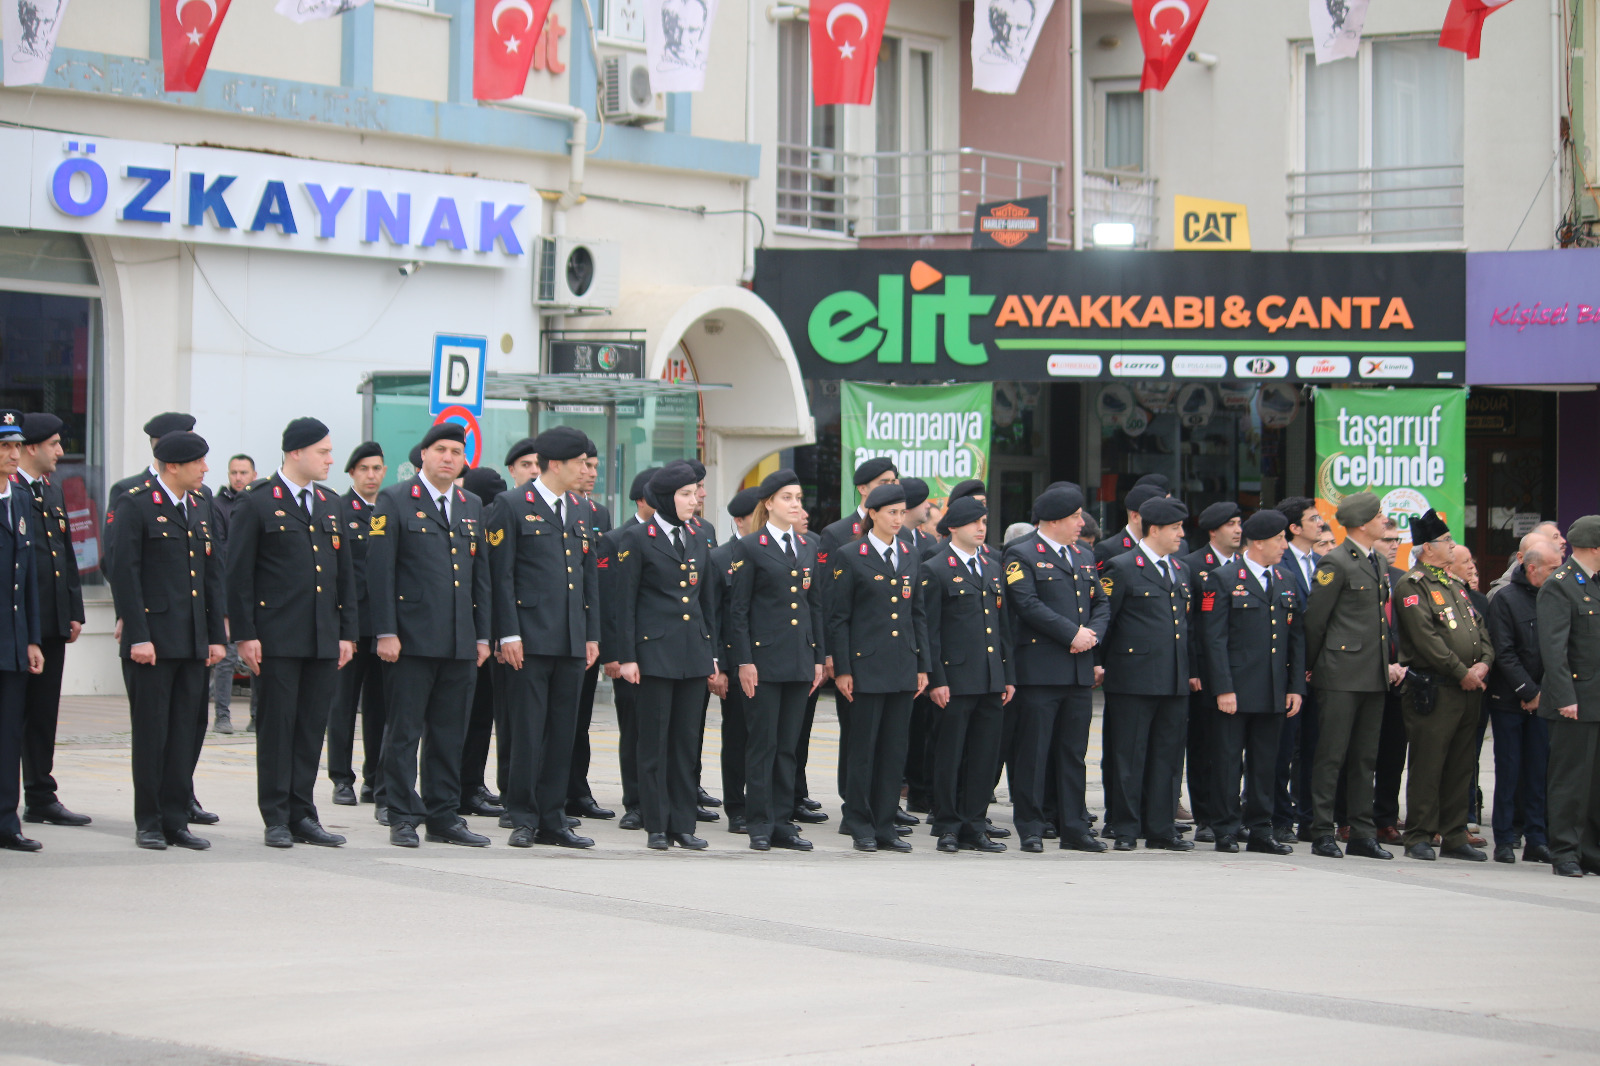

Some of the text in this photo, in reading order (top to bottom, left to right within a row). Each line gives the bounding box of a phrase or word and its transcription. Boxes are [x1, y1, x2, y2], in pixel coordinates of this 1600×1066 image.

[47, 140, 525, 256] ÖZKAYNAK
[1183, 211, 1238, 243] CAT
[807, 260, 997, 366] elit
[446, 354, 470, 397] D
[1311, 364, 1336, 375] JUMP
[866, 401, 982, 447] kampanya
[1333, 445, 1445, 488] cebinde
